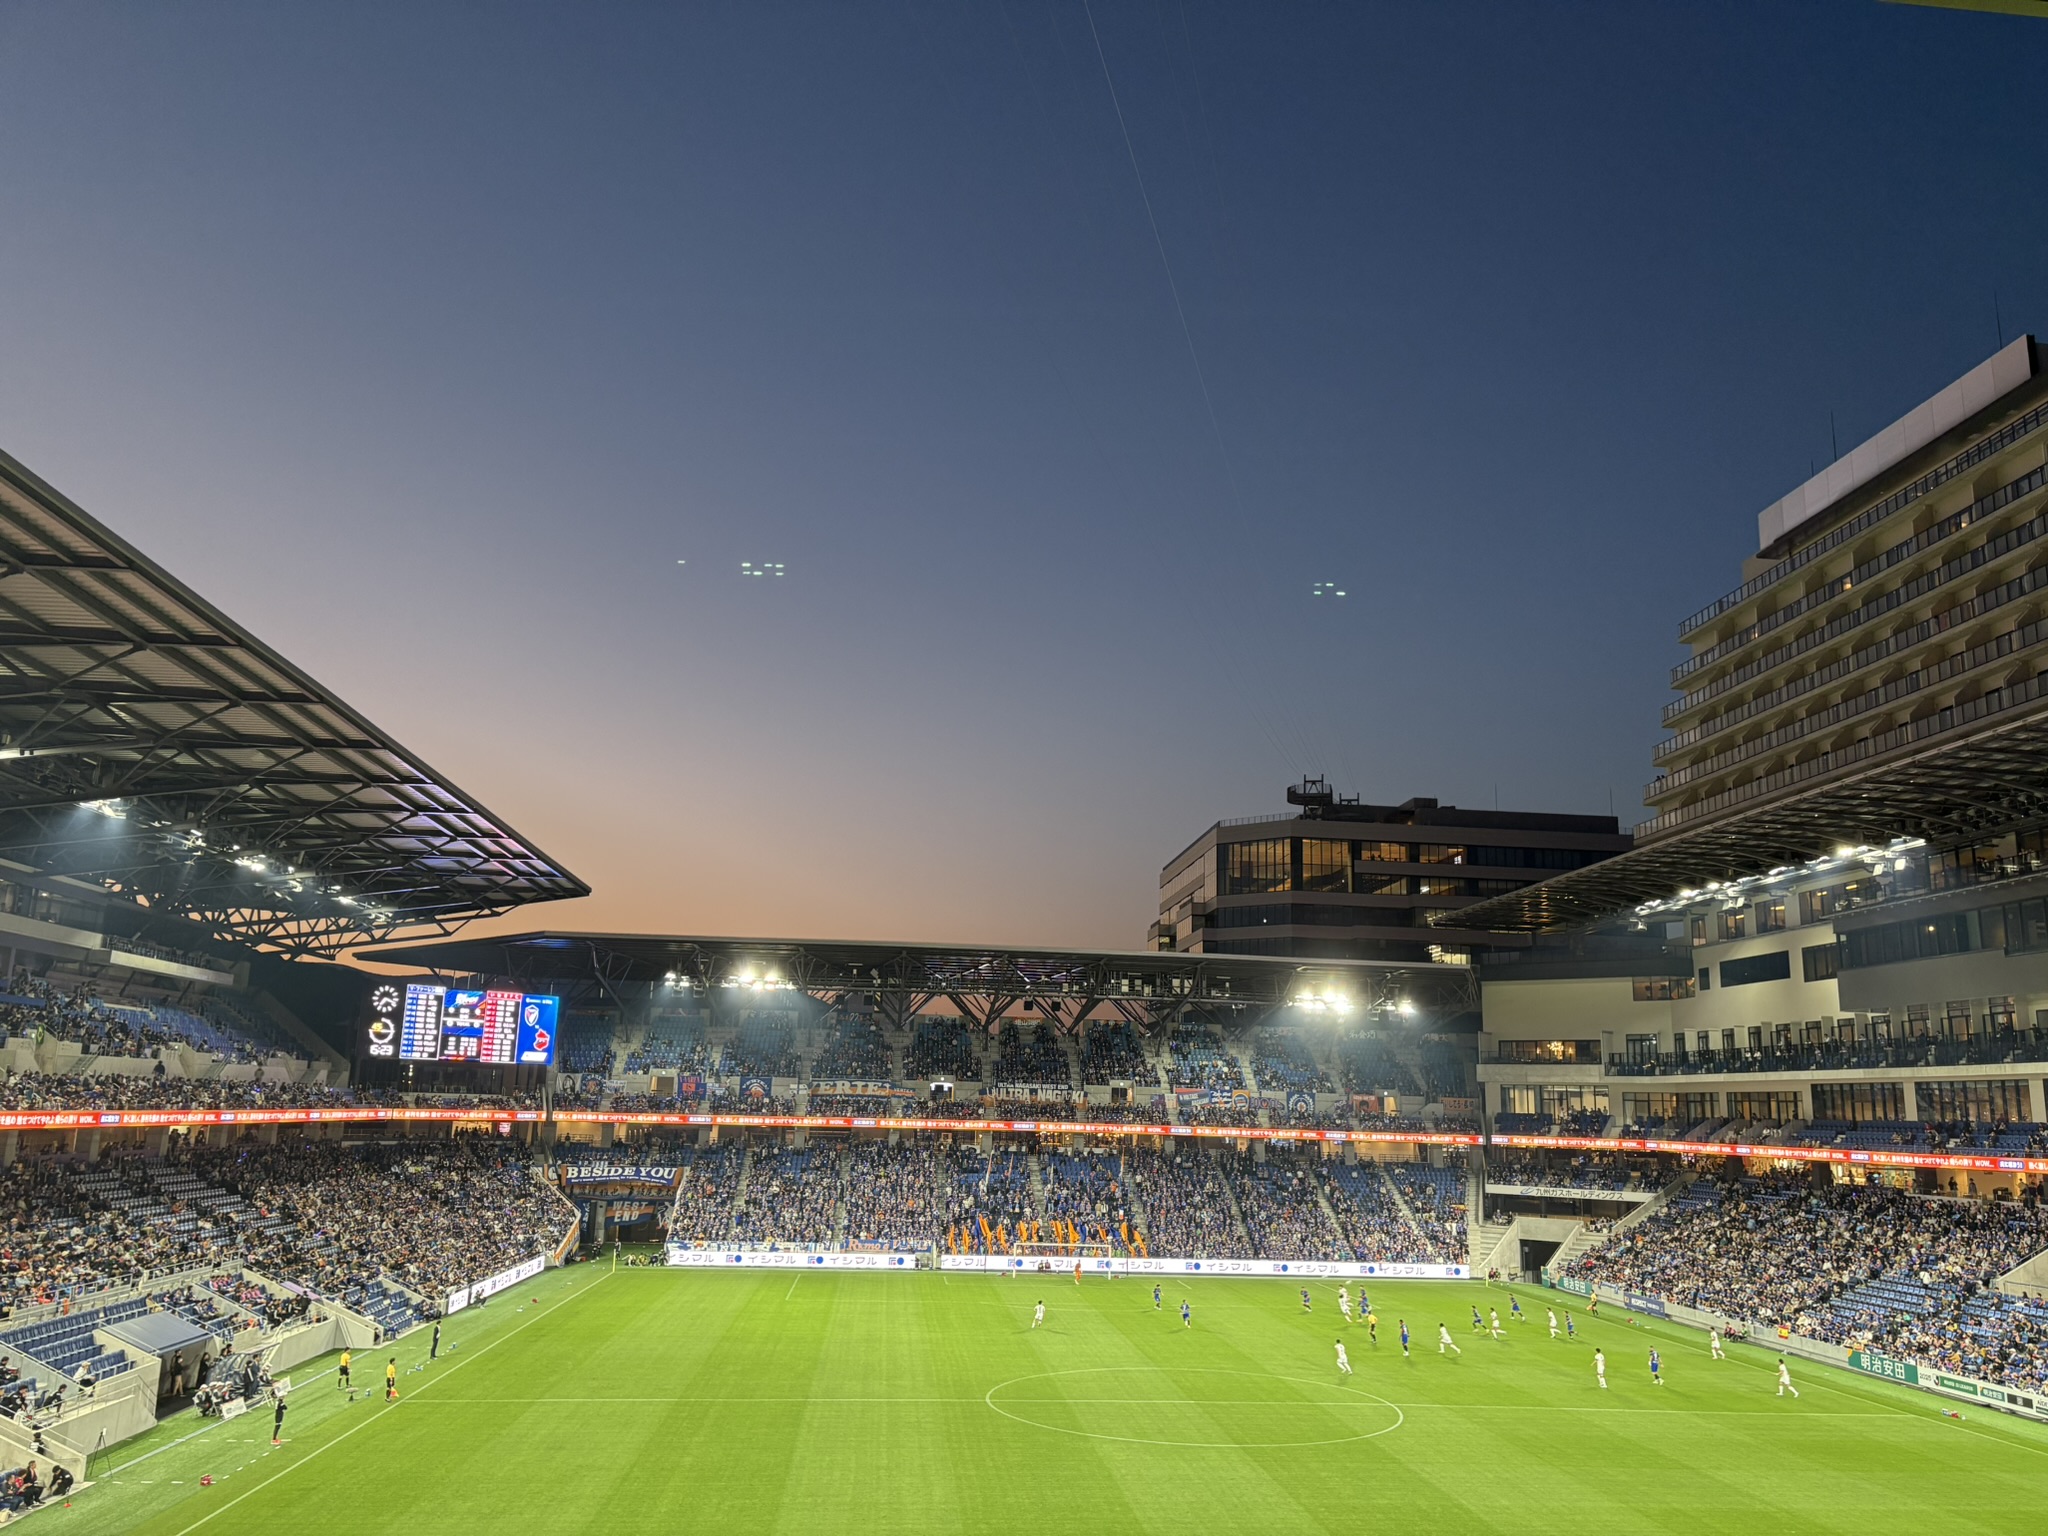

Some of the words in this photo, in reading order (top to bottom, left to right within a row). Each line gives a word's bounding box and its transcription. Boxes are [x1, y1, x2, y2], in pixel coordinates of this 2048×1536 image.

[566, 1166, 635, 1178] BESIDE
[640, 1167, 678, 1180] YOU
[1536, 1188, 1625, 1200] 九州ガスホールディングス
[612, 1200, 648, 1211] WEST
[614, 1210, 640, 1222] END
[748, 1255, 796, 1264] イシマル
[830, 1256, 877, 1265] イシマル
[1029, 1260, 1074, 1268] イマル
[1118, 1261, 1164, 1270] イシマル
[1206, 1262, 1252, 1272] イシマル
[1294, 1264, 1339, 1274] イシマル
[1860, 1352, 1906, 1380] 明治安田
